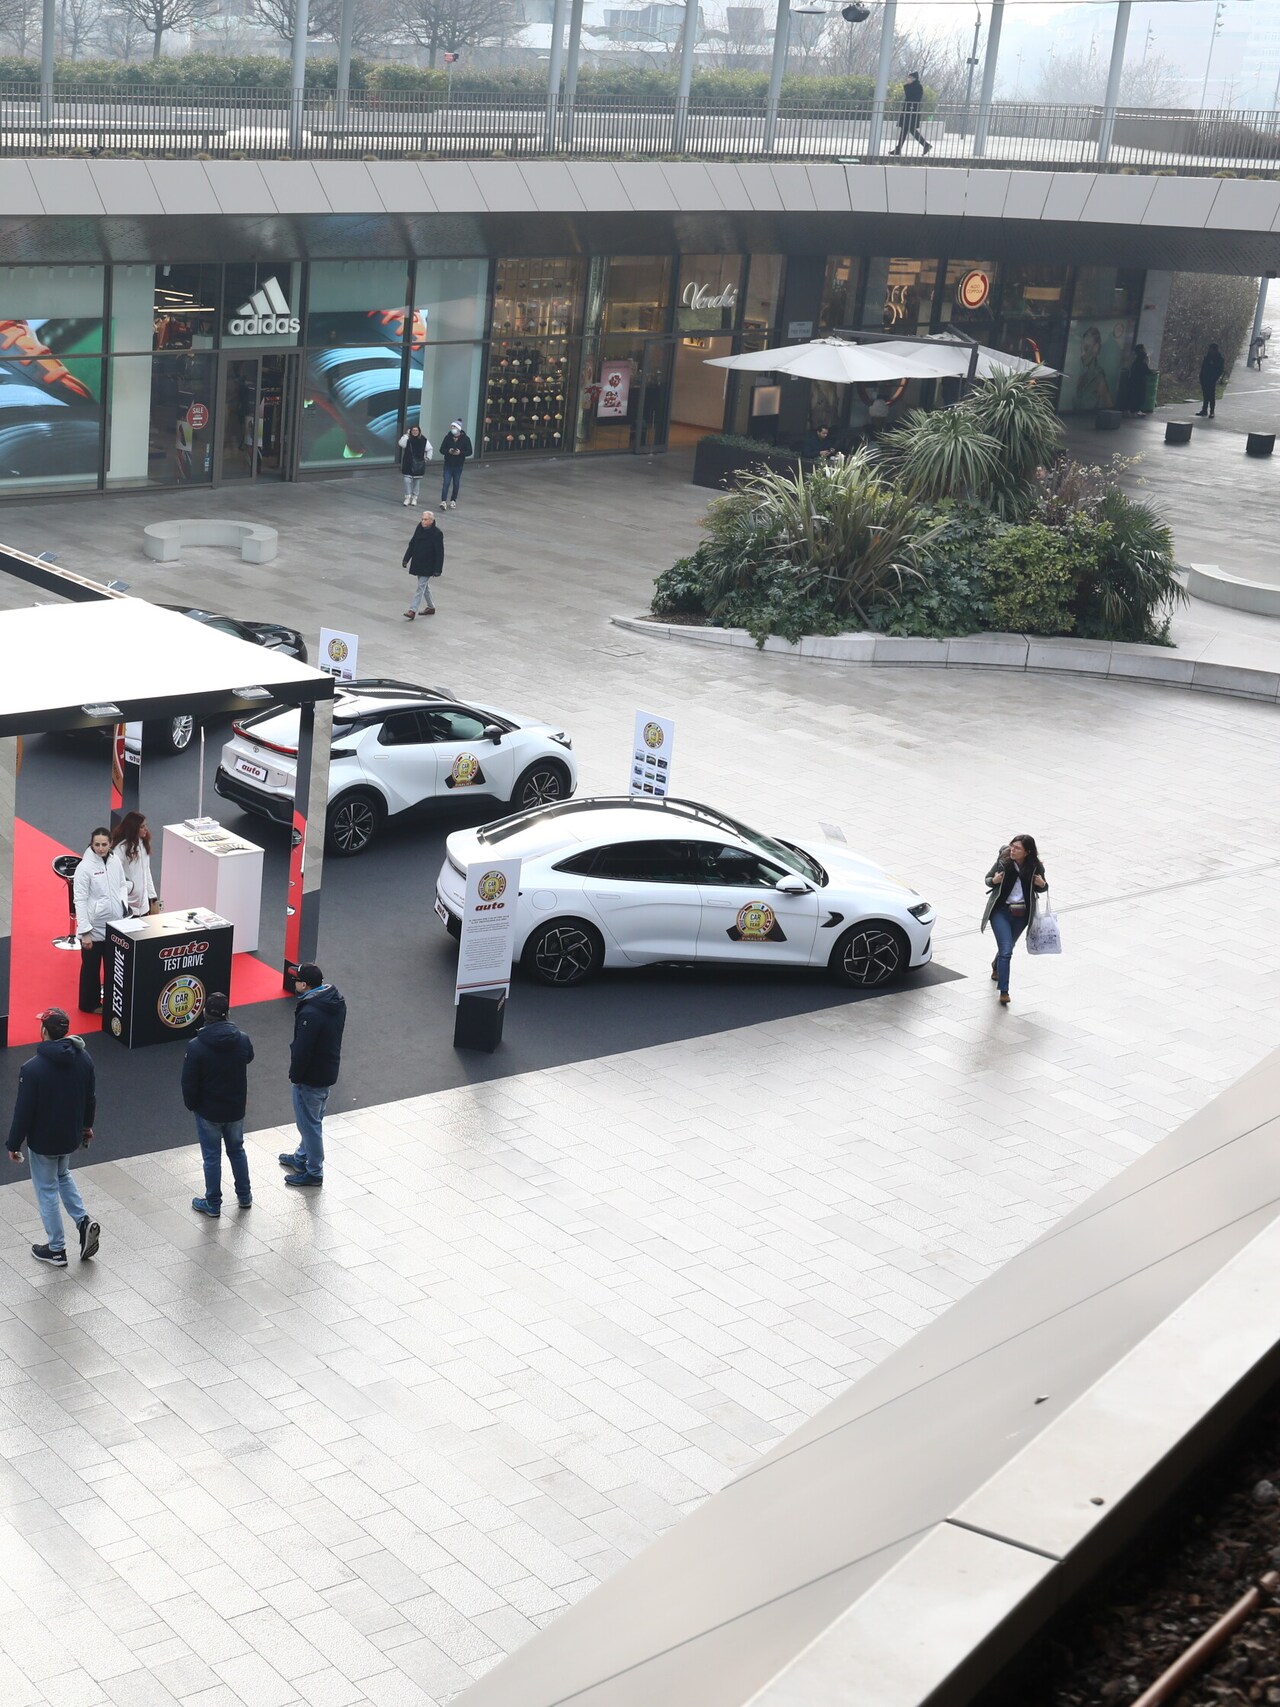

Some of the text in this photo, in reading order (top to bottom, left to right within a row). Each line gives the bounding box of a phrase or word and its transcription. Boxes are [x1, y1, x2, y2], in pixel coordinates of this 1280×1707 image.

[229, 313, 300, 336] adidas
[242, 764, 260, 776] auto
[475, 902, 505, 912] auto
[110, 934, 130, 950] auto
[159, 940, 210, 959] auto
[164, 954, 204, 972] TEST DRIVE
[112, 946, 125, 1018] TEST DRIVE
[176, 993, 188, 1004] CAR
